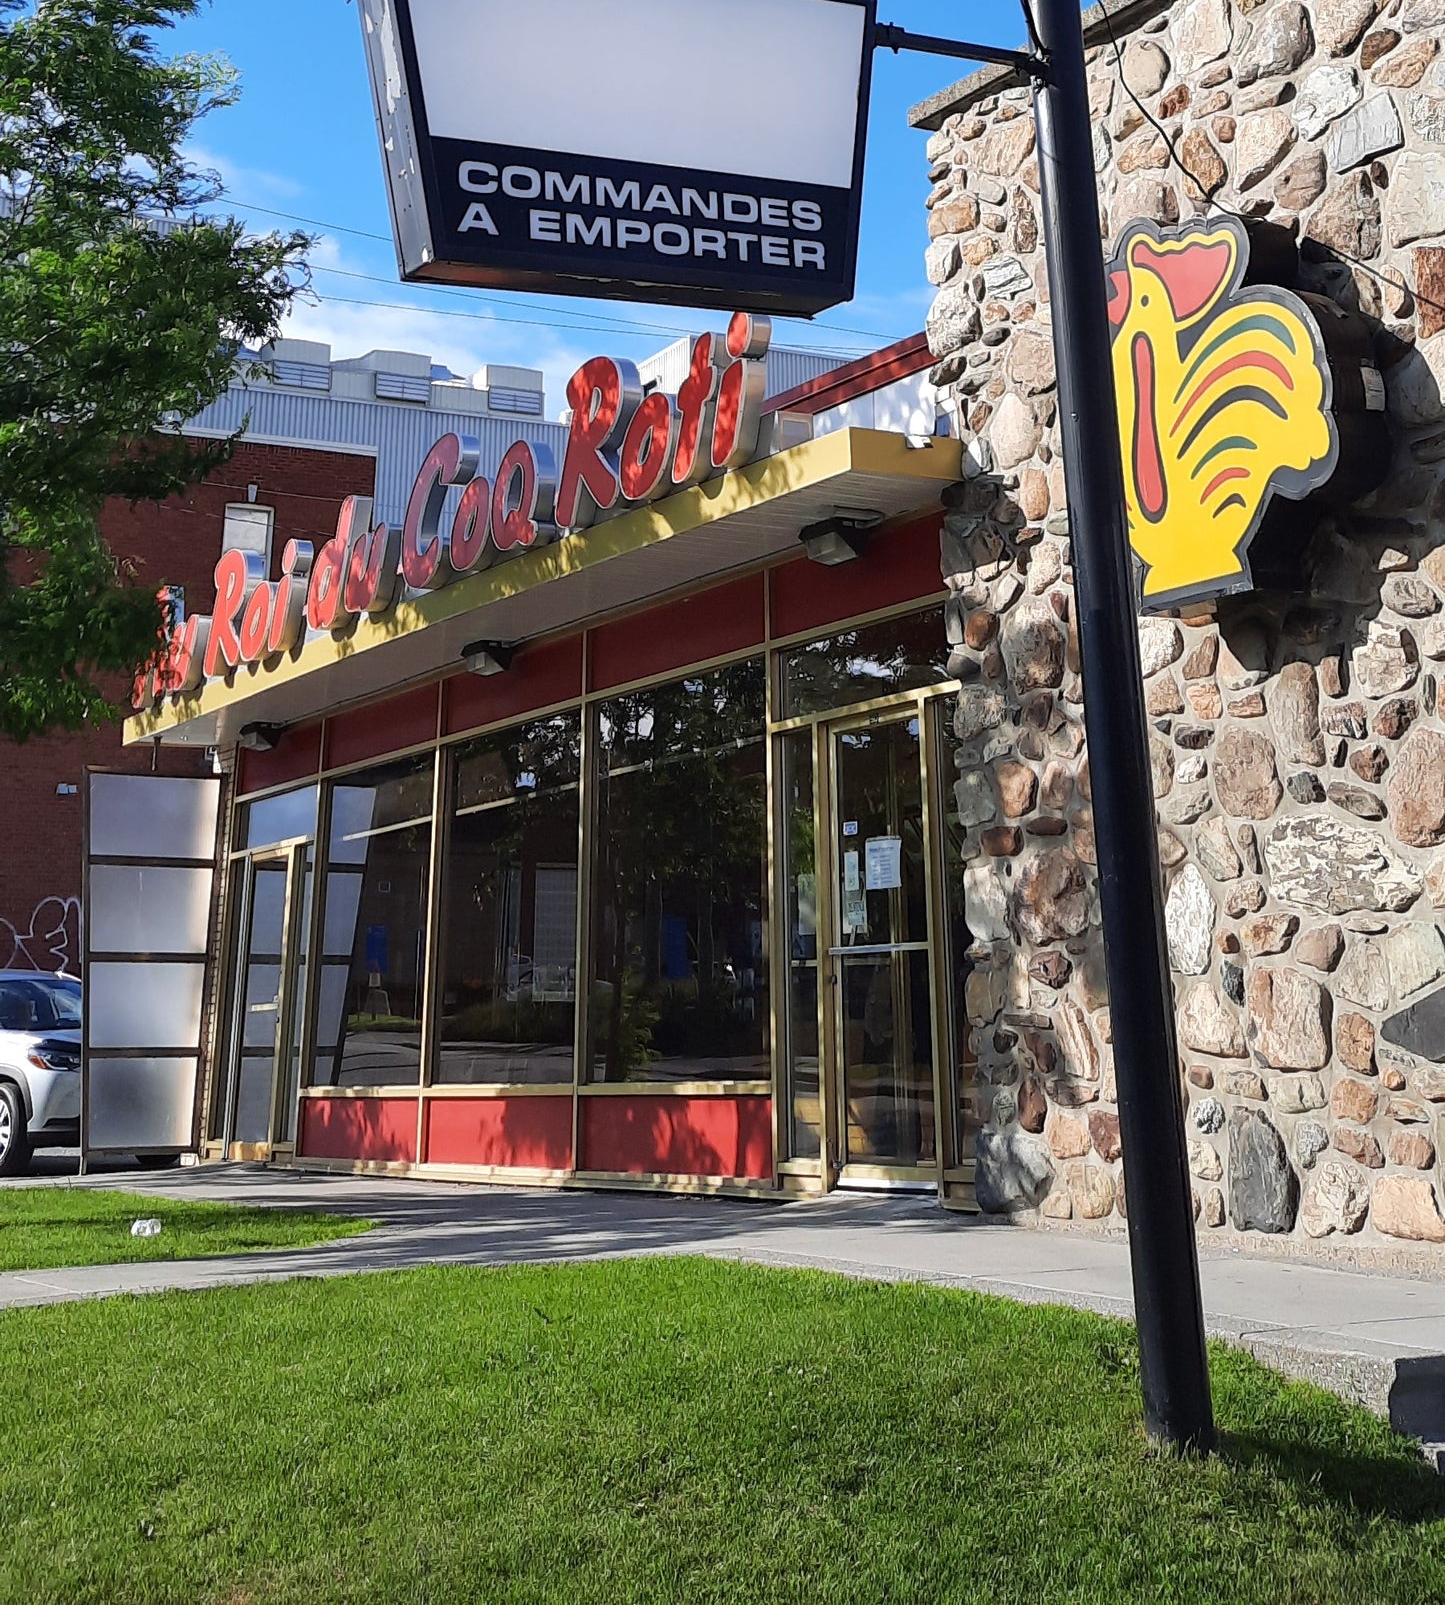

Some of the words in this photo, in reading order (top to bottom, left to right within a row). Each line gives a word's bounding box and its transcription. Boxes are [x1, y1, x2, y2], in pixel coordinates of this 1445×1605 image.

[458, 160, 823, 232] COMMANDES
[457, 202, 500, 236] A
[529, 209, 826, 271] EMPORTER
[203, 539, 298, 678] Roi
[306, 495, 387, 631] du
[554, 311, 752, 528] Roti
